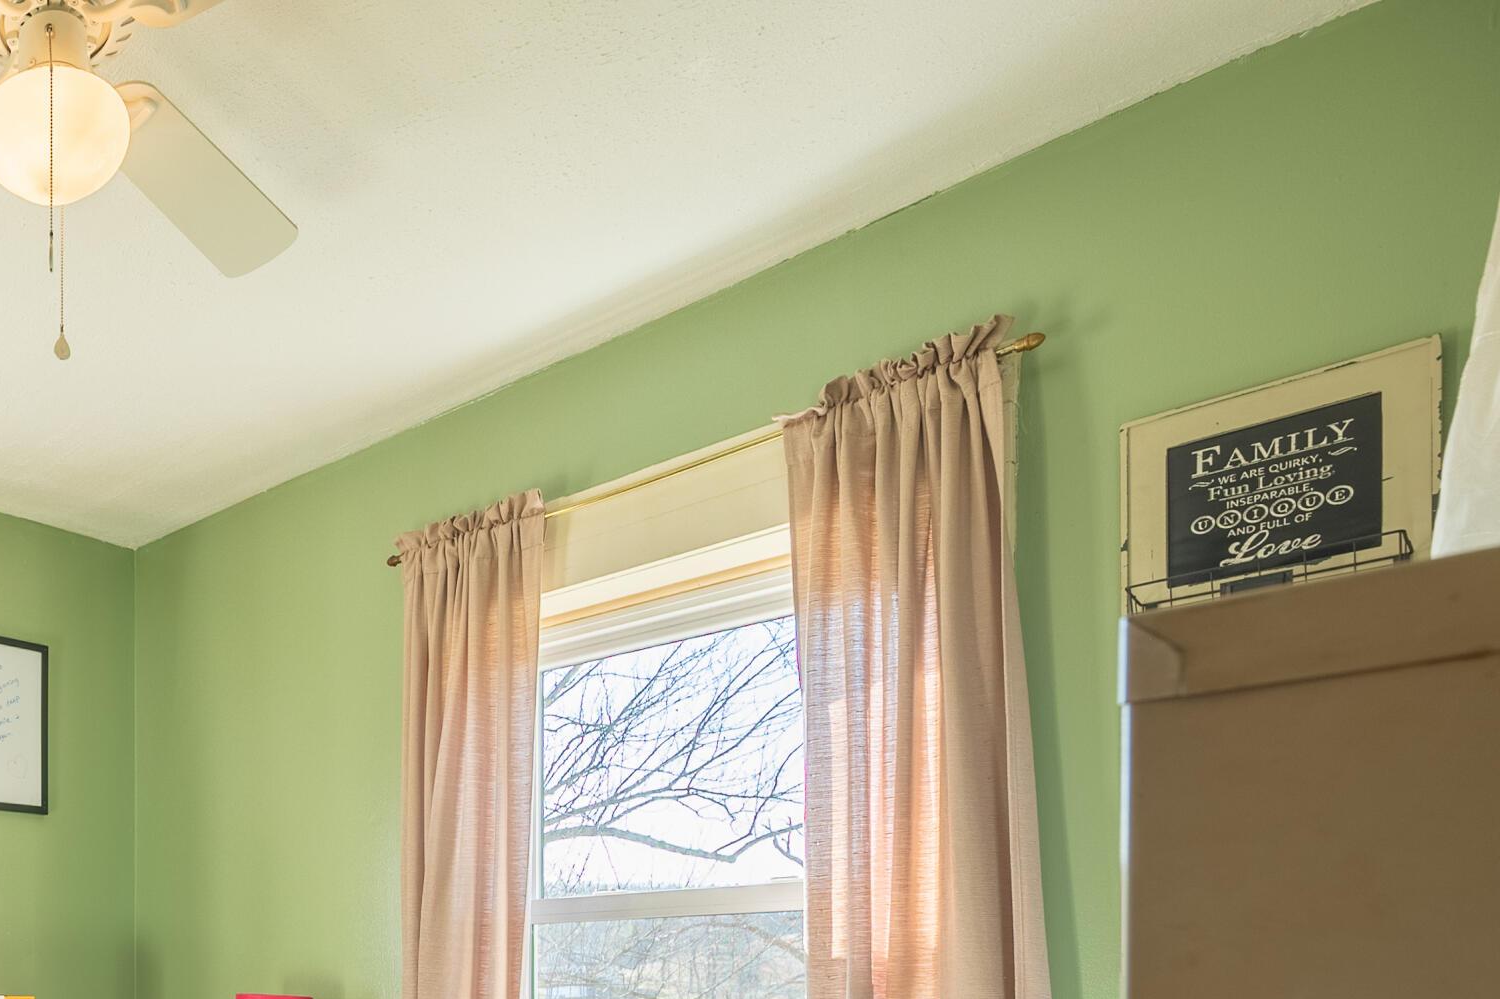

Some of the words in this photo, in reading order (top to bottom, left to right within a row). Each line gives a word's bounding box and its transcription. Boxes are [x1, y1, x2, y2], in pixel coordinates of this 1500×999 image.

[1190, 418, 1355, 479] FAMILY
[1218, 474, 1237, 485] WE
[1240, 467, 1265, 481] ARE
[1268, 454, 1323, 473] QUIRKY,
[1207, 483, 1250, 501] Fun
[1226, 483, 1314, 509] INSEPARABLE,
[1194, 487, 1349, 532] UNIQUE
[1227, 524, 1256, 537] AND
[1260, 518, 1291, 531] FULL
[1294, 512, 1313, 524] OF
[1219, 529, 1322, 567] Love
